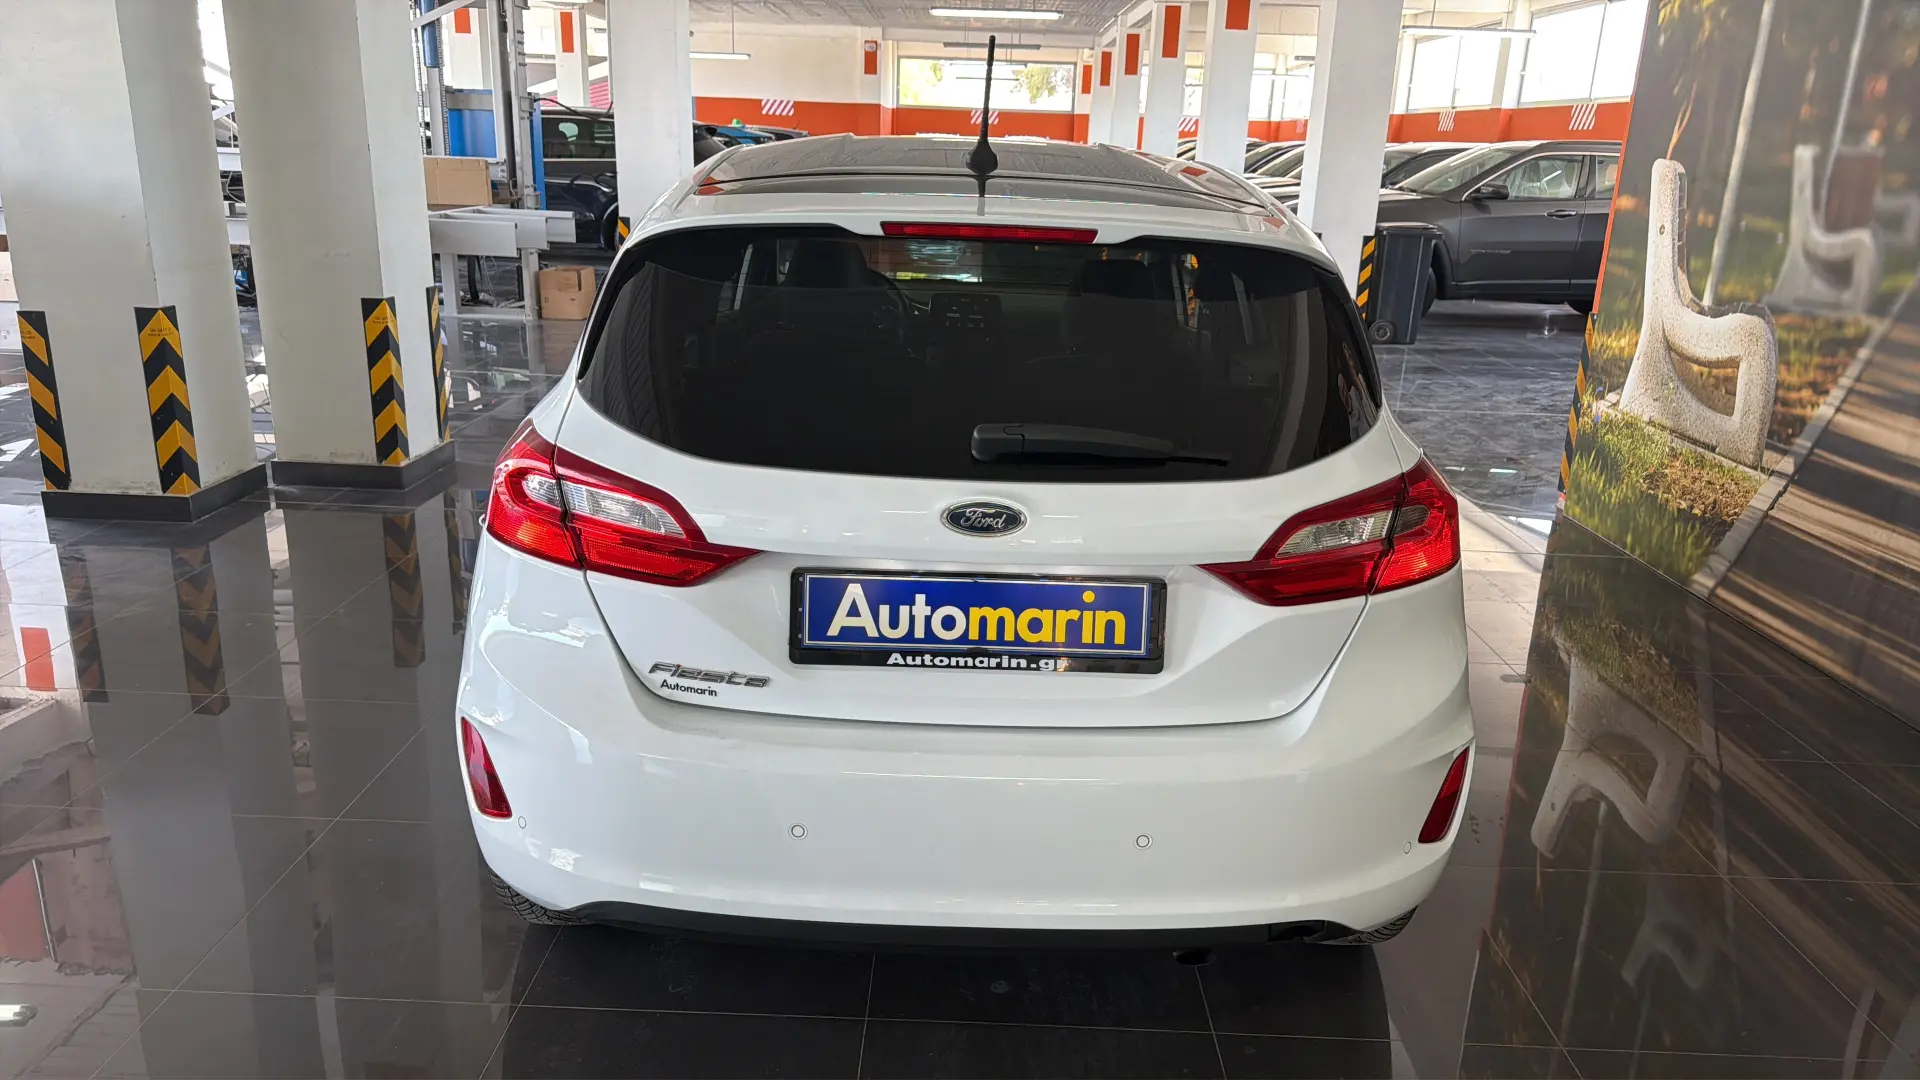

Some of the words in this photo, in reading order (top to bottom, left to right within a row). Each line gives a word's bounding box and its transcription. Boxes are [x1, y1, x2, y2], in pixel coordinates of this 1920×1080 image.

[961, 508, 1007, 528] Ford
[826, 583, 1126, 645] Automarin
[886, 652, 1069, 672] Automarin.gr
[648, 661, 769, 688] Fiesta
[660, 679, 717, 697] Automarin
